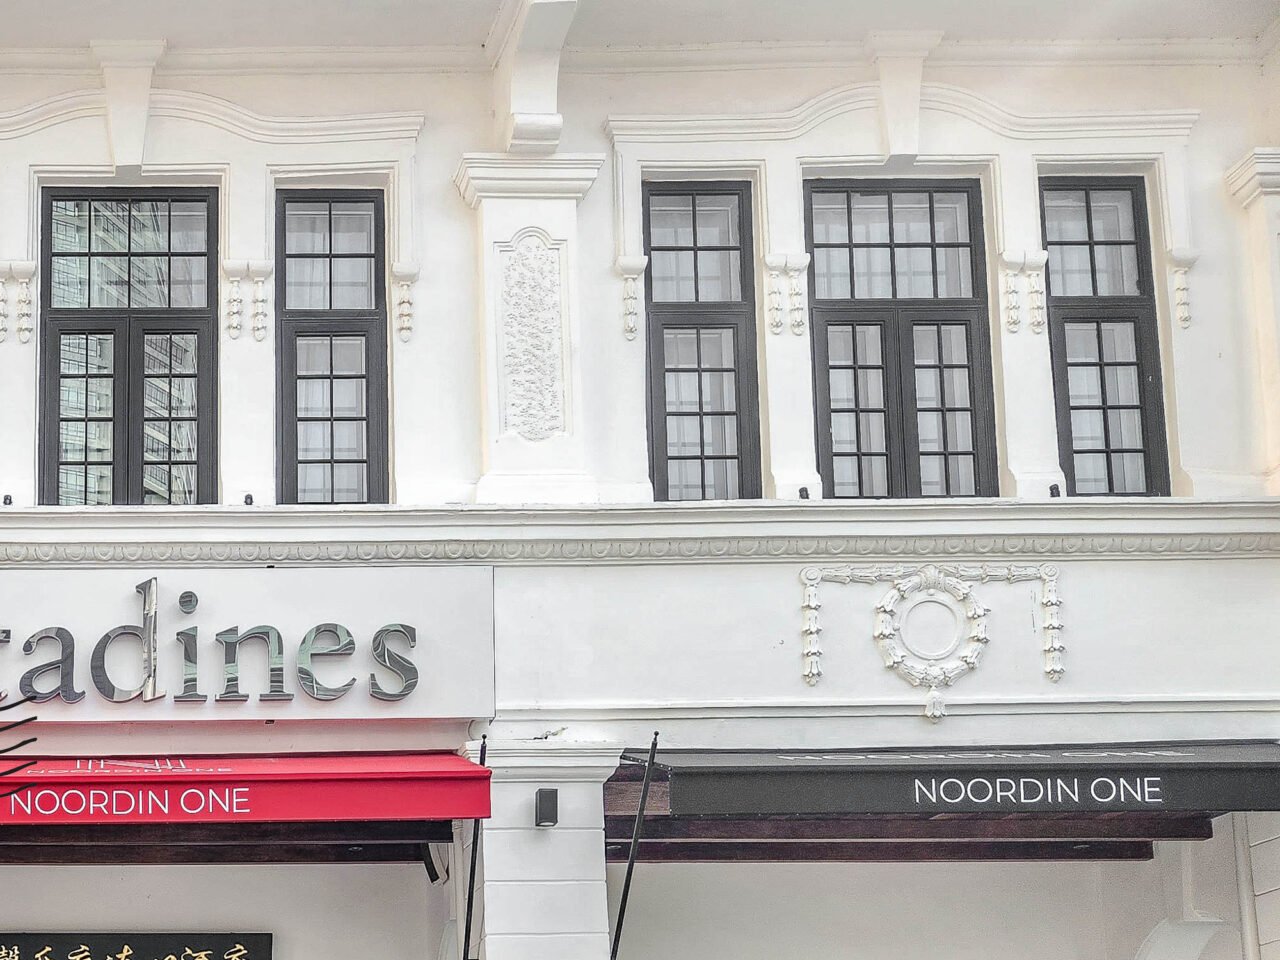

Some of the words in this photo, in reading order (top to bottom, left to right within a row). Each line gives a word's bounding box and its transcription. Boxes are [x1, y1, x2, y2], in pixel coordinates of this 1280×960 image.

[10, 789, 170, 816] NOORDIN
[180, 787, 251, 814] ONE
[914, 777, 1080, 805] NOORDIN
[1090, 776, 1164, 803] ONE
